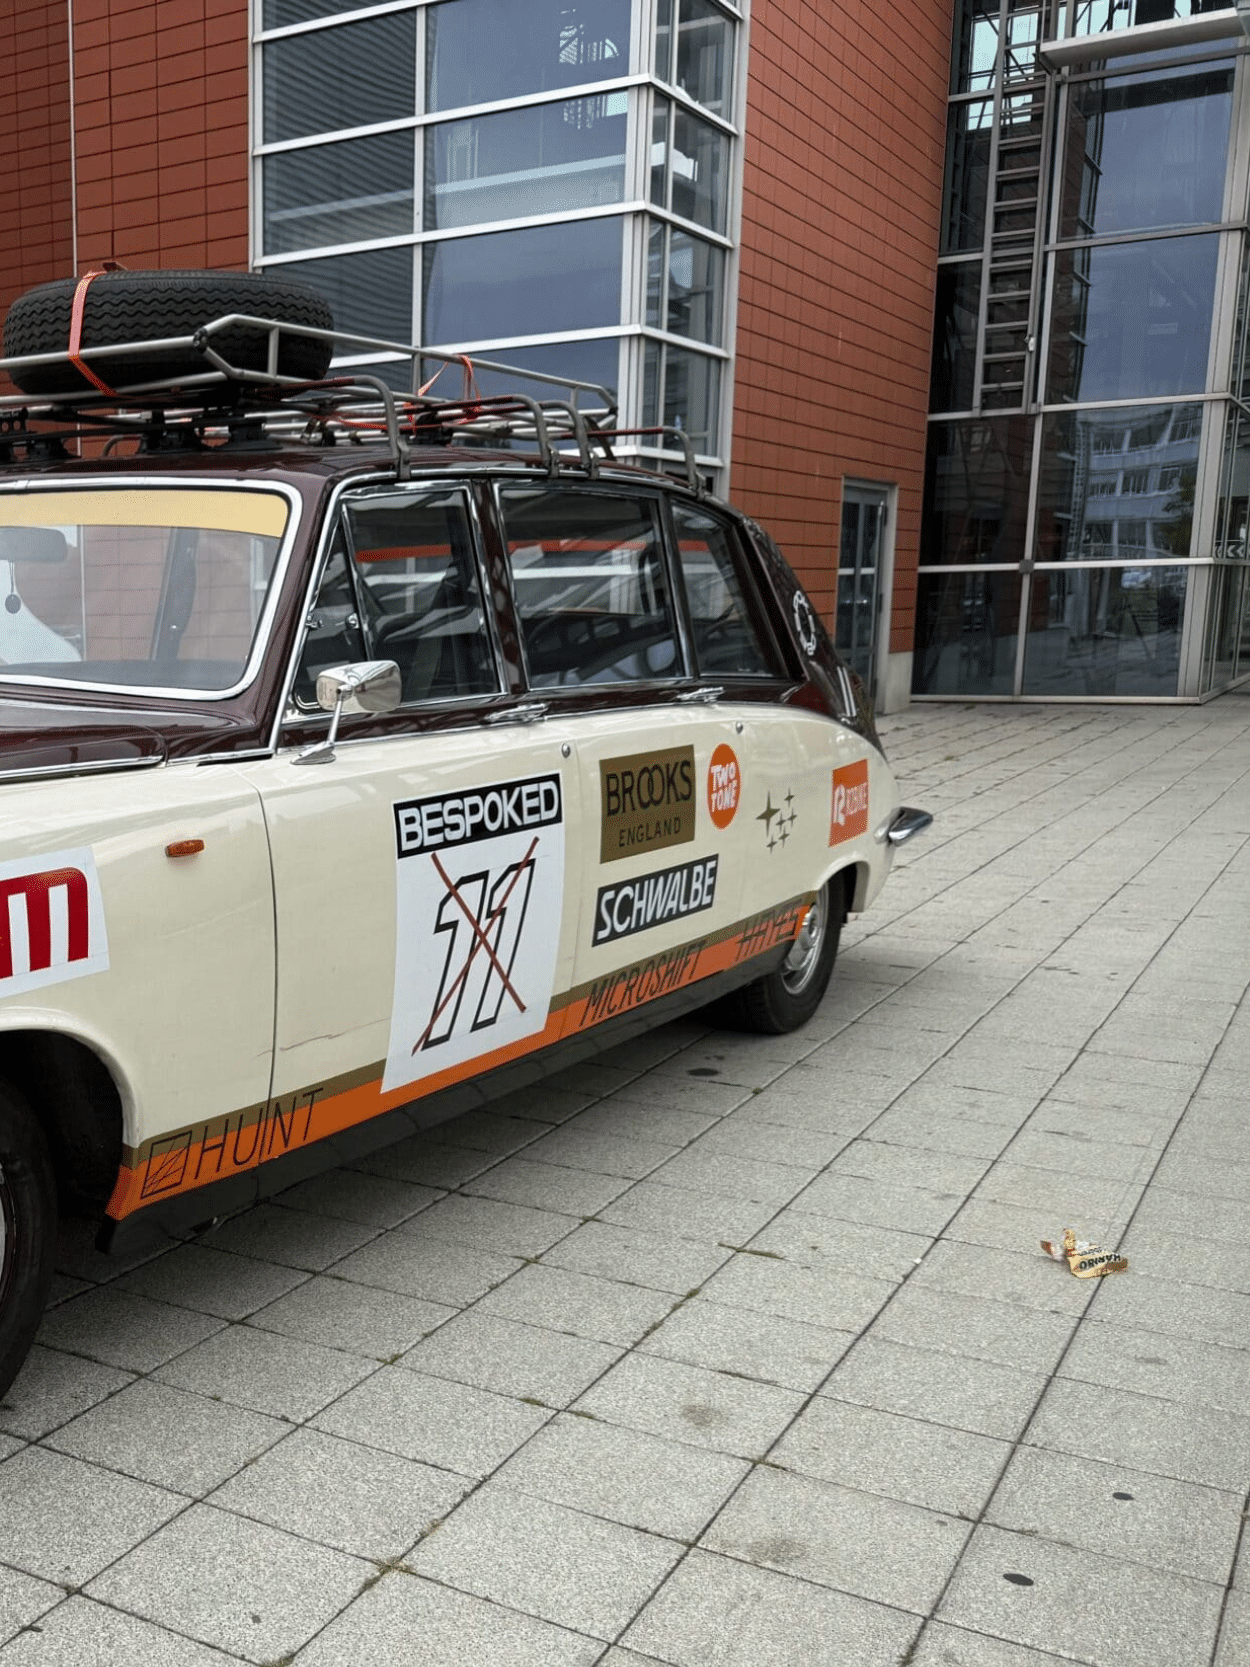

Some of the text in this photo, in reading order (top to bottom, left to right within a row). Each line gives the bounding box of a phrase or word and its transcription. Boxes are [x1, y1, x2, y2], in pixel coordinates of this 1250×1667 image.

[606, 760, 692, 817] BROOKS
[711, 761, 736, 792] TWO
[711, 780, 737, 812] TONE
[398, 780, 559, 851] BESPOKED
[618, 817, 681, 847] ENGLAND
[597, 860, 717, 940] SCHWALBE
[421, 858, 536, 1051] 11
[579, 939, 706, 1027] MICROSHIFT
[194, 1087, 323, 1180] HUNT
[1079, 1253, 1121, 1270] HARIBO
